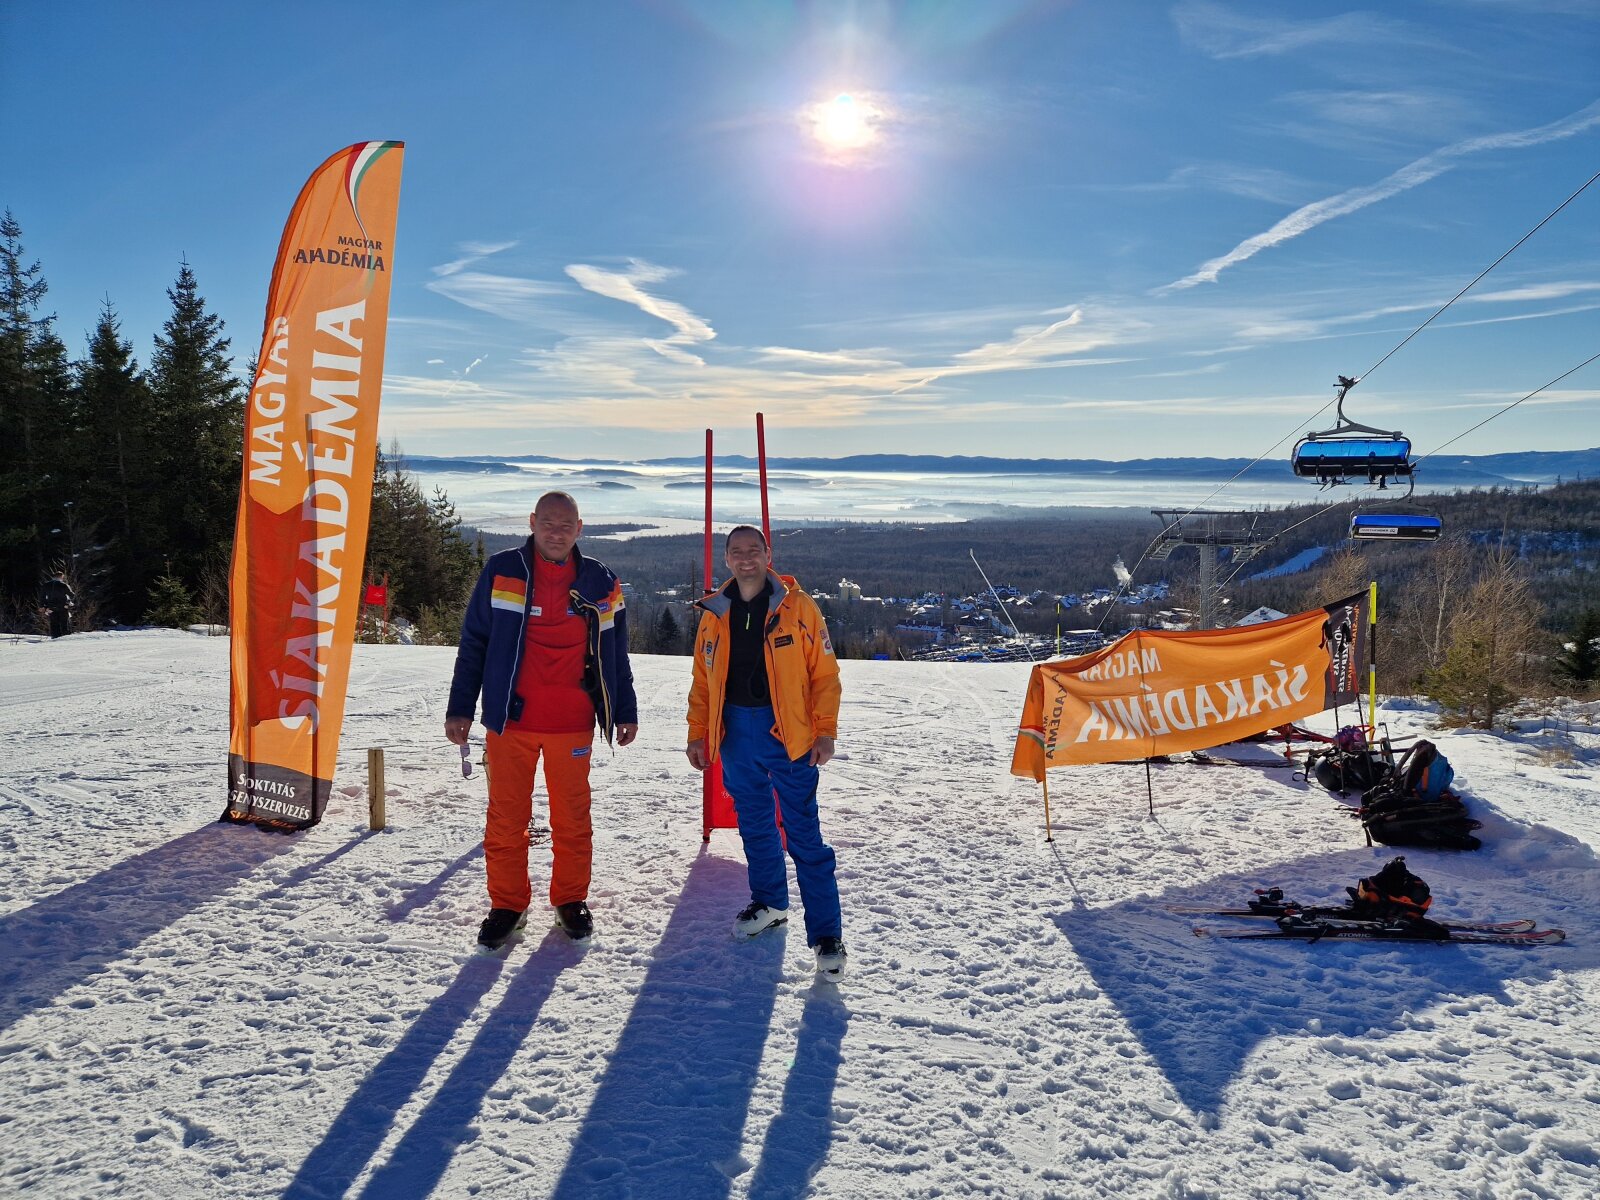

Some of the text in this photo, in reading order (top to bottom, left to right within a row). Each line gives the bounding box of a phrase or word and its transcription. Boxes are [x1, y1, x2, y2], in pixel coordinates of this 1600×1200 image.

[337, 235, 382, 250] MAGYAR
[249, 316, 289, 487] MAGYAR
[269, 298, 366, 736] SÍAKADÉMIA
